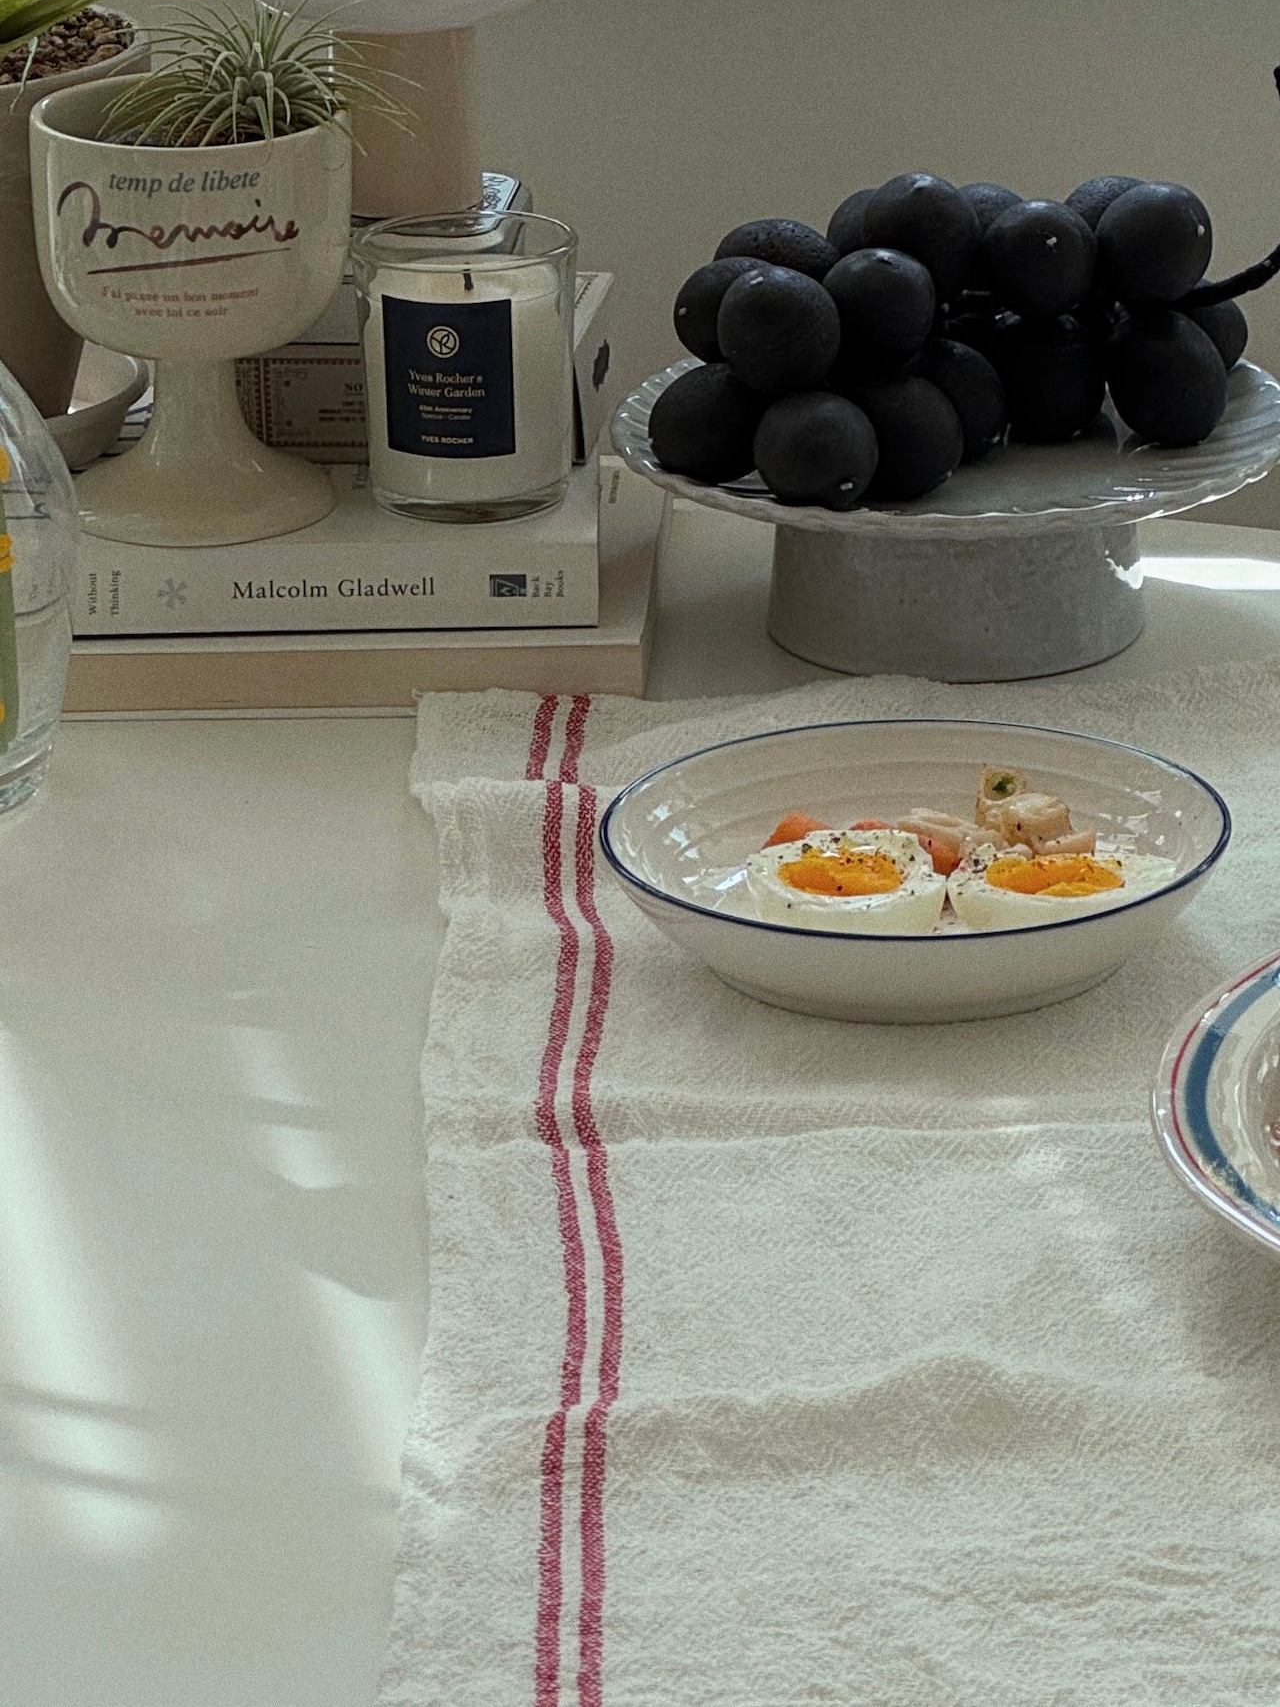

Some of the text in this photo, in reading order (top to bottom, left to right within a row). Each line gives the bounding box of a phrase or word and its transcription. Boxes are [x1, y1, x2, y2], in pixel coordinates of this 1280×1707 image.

[108, 170, 260, 198] temp de libete
[408, 369, 433, 383] Yves
[407, 382, 486, 398] Winter Garden
[420, 435, 474, 445] YVES ROCHER
[87, 572, 97, 615] Without
[109, 569, 121, 617] Thinking
[231, 576, 435, 600] Malcolm Gladwell
